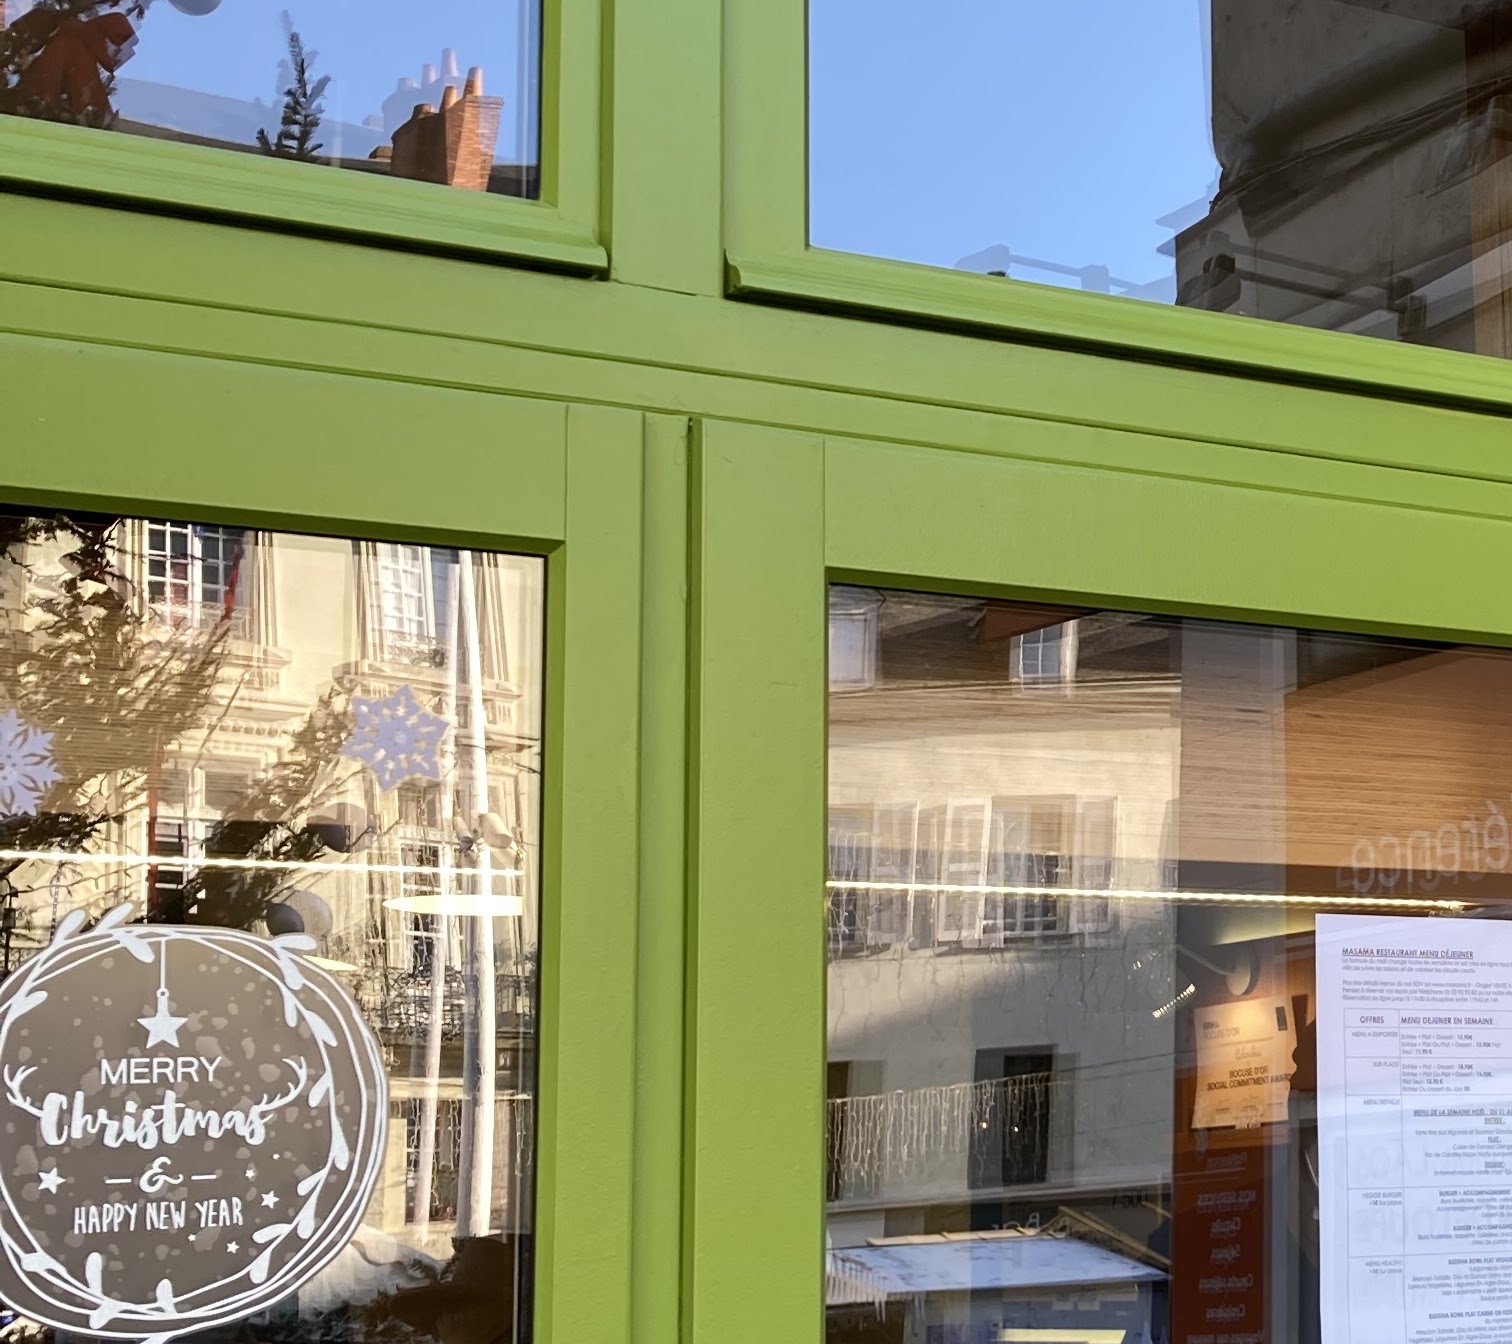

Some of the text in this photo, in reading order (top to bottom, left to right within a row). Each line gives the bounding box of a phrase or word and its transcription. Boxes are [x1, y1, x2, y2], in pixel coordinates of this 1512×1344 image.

[1342, 947, 1374, 957] MASAMA
[1376, 948, 1418, 958] RESTAURANT
[1420, 949, 1439, 959] MENU
[1360, 1015, 1385, 1025] OFFRES
[1401, 1016, 1421, 1025] MENU
[1453, 1017, 1462, 1025] EN
[99, 1055, 224, 1087] MERRY
[1206, 1080, 1230, 1092] SOCIAL
[40, 1090, 274, 1149] Christmas
[139, 1156, 184, 1194] &
[74, 1197, 244, 1235] HAPPY NEW YEAR
